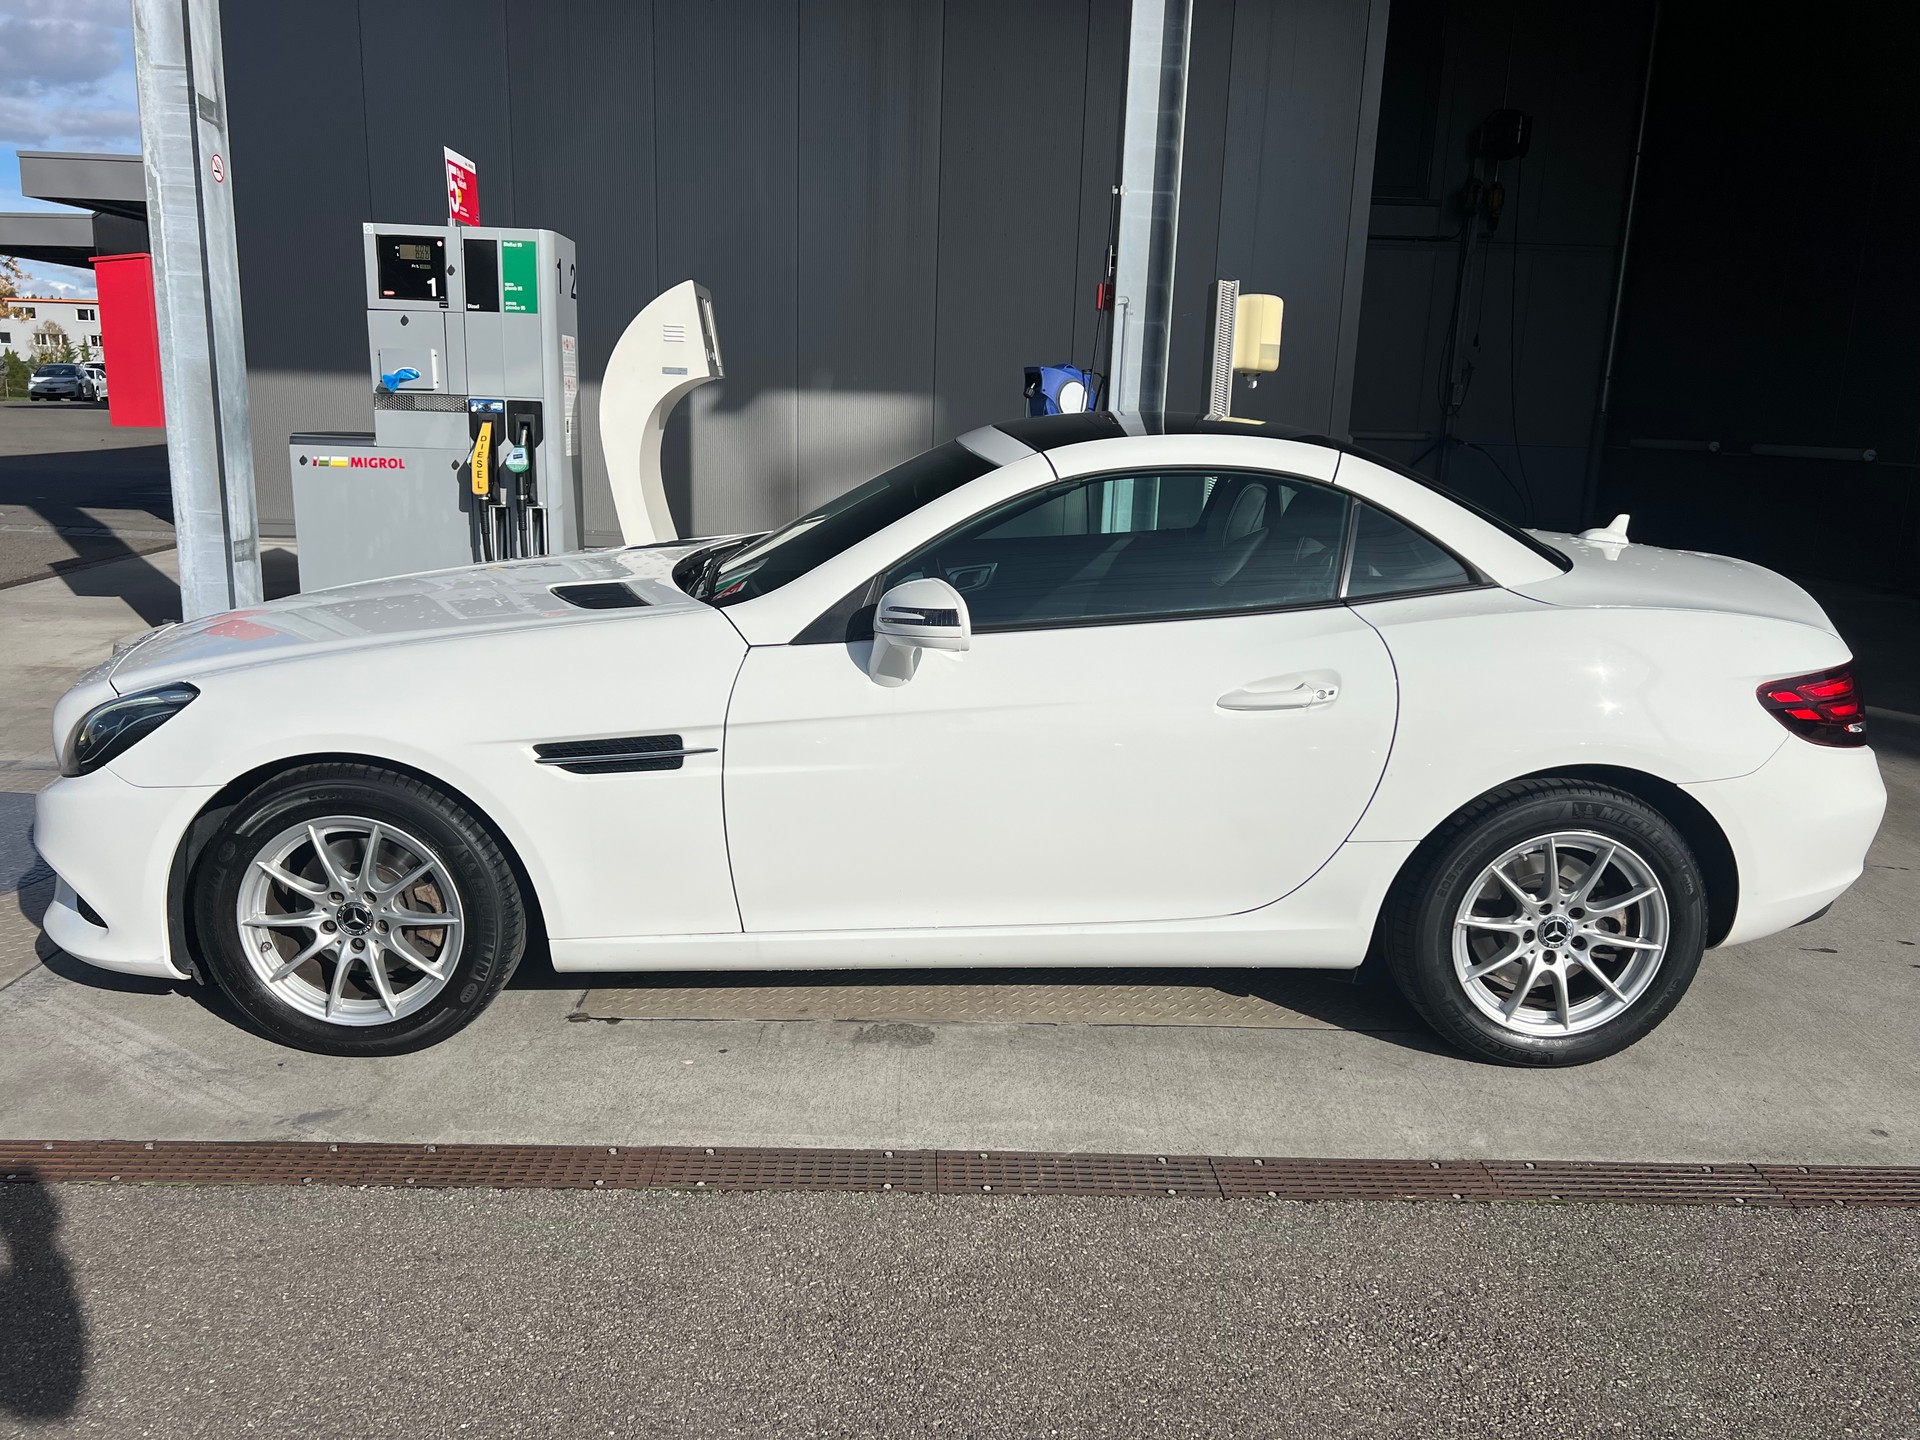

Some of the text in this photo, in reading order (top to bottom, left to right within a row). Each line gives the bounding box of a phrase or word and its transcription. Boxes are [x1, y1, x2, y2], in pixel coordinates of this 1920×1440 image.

[448, 163, 460, 213] 5
[427, 277, 437, 297] 1
[557, 258, 577, 299] 1 2
[350, 457, 405, 469] MIGROL
[477, 435, 487, 489] DIESEL
